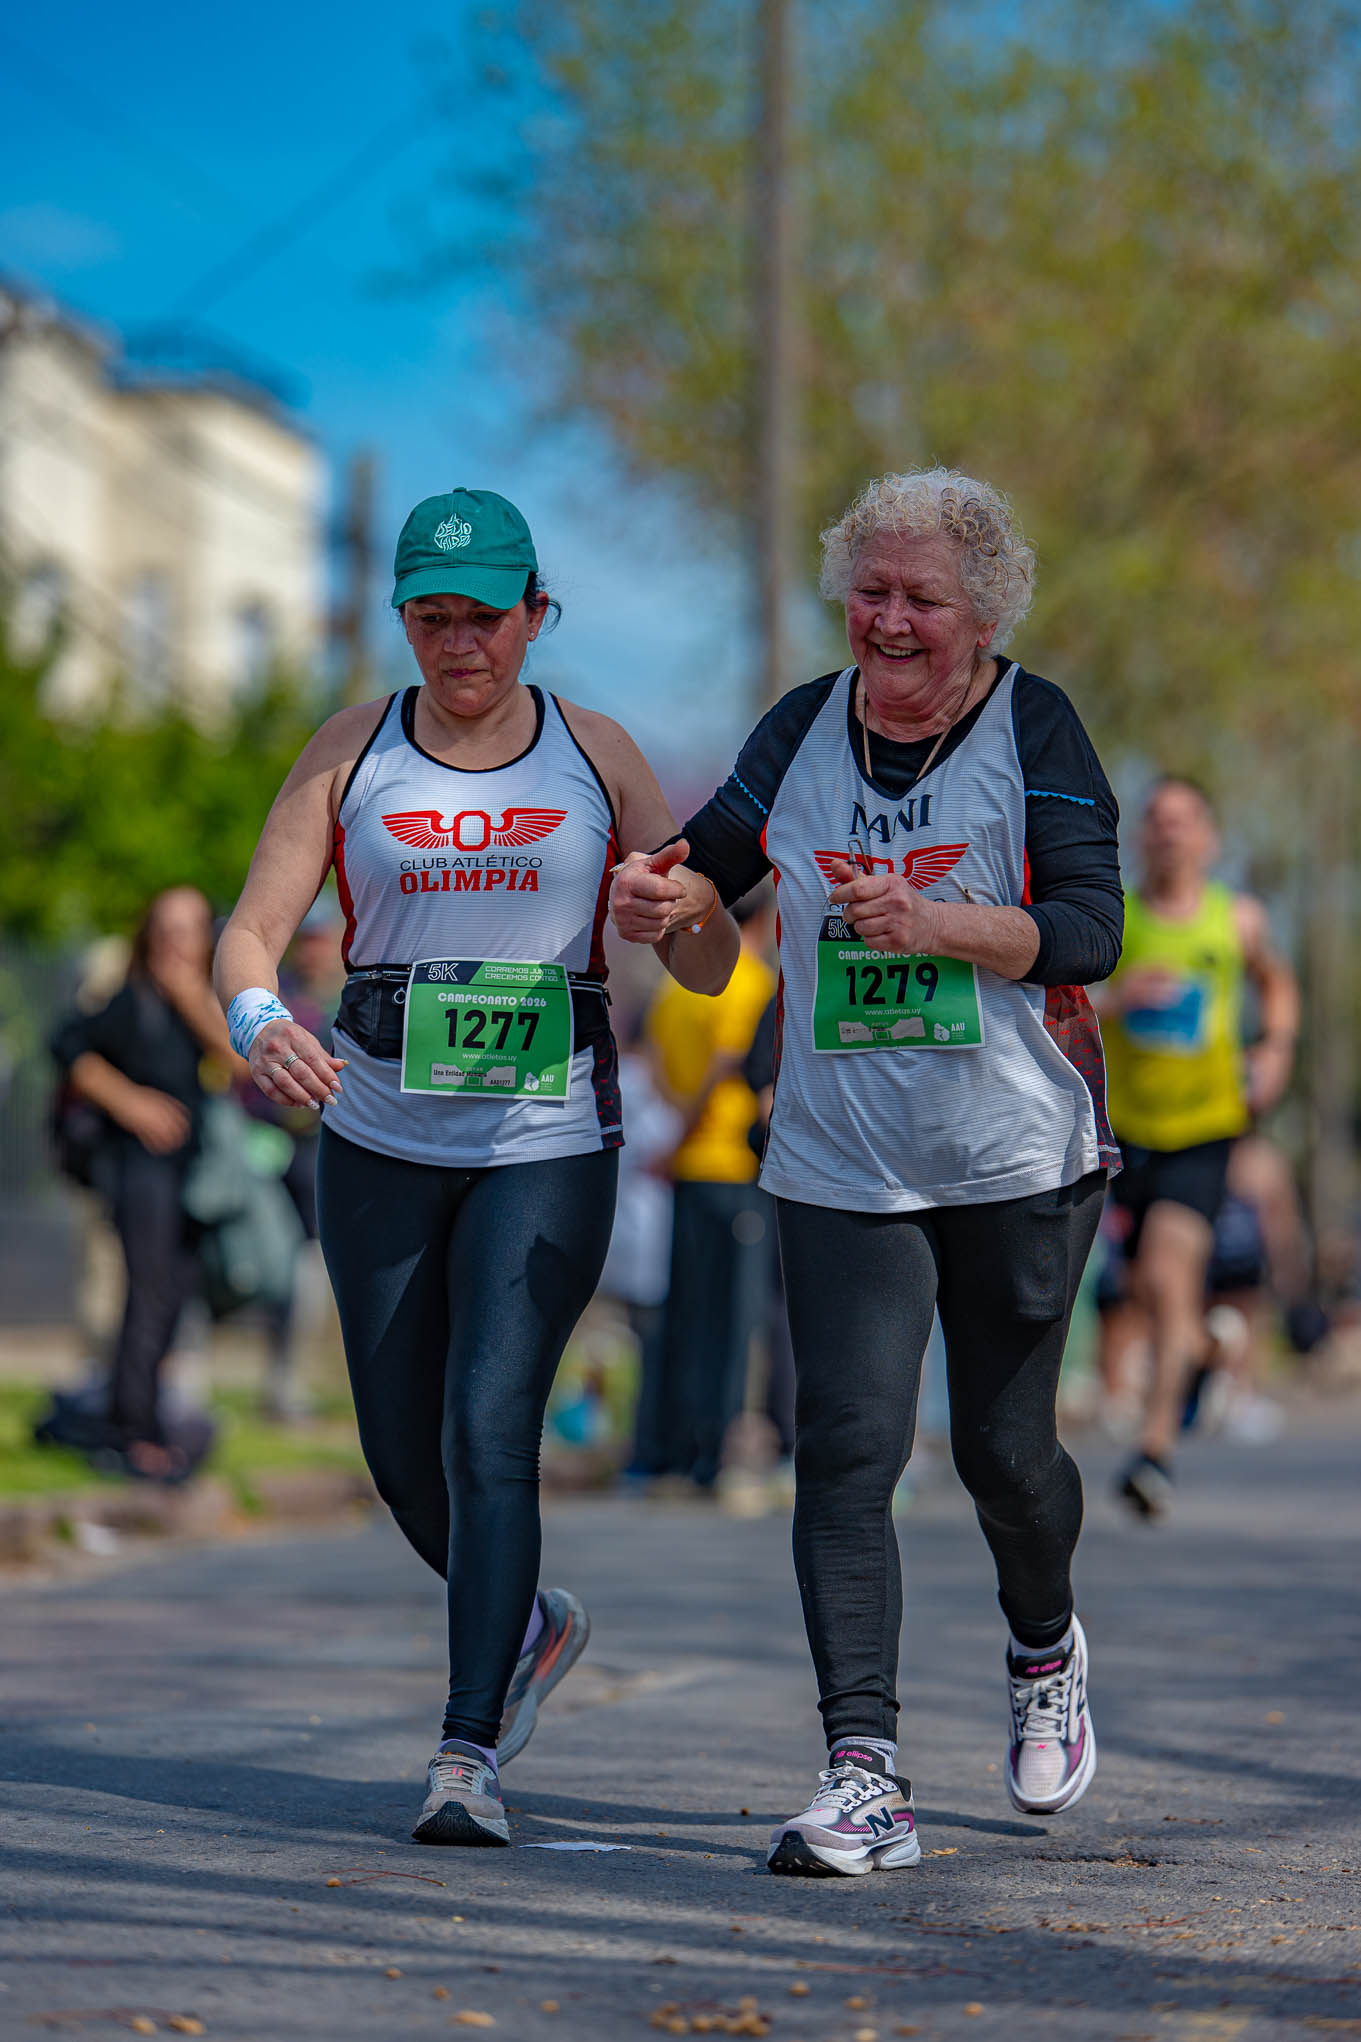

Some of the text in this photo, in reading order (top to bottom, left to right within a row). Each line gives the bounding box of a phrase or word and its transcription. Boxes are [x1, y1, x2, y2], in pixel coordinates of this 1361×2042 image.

[849, 794, 933, 843] NANI
[400, 854, 543, 871] CLUB ATLÉTICO
[400, 869, 539, 895] OLIMPIA
[828, 918, 851, 938] 5K
[428, 963, 459, 981] 5K
[485, 966, 529, 974] CORREMOS
[485, 973, 529, 981] CRECEMOS
[846, 962, 939, 1005] 1279
[437, 992, 547, 1007] CAMPEONATO 2026
[865, 1008, 921, 1016] www.atletas.uy
[445, 1008, 540, 1051] 1277
[951, 1023, 965, 1031] AAU
[462, 1053, 517, 1062] www.atletas.uy
[541, 1074, 554, 1082] AAU
